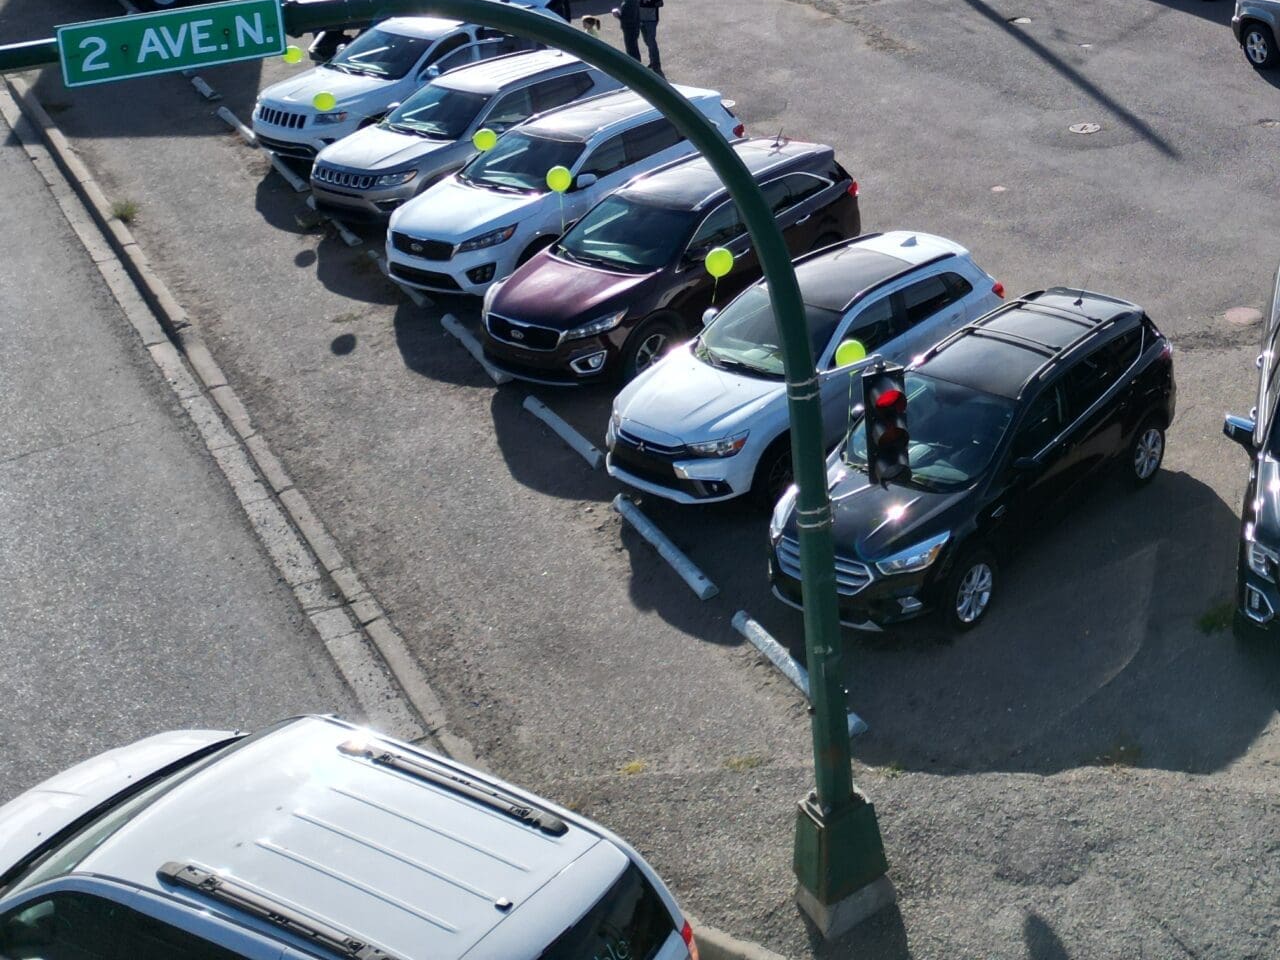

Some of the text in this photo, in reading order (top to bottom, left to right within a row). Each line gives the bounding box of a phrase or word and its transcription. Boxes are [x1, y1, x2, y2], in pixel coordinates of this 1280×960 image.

[78, 12, 274, 72] 2 AVE. N.
